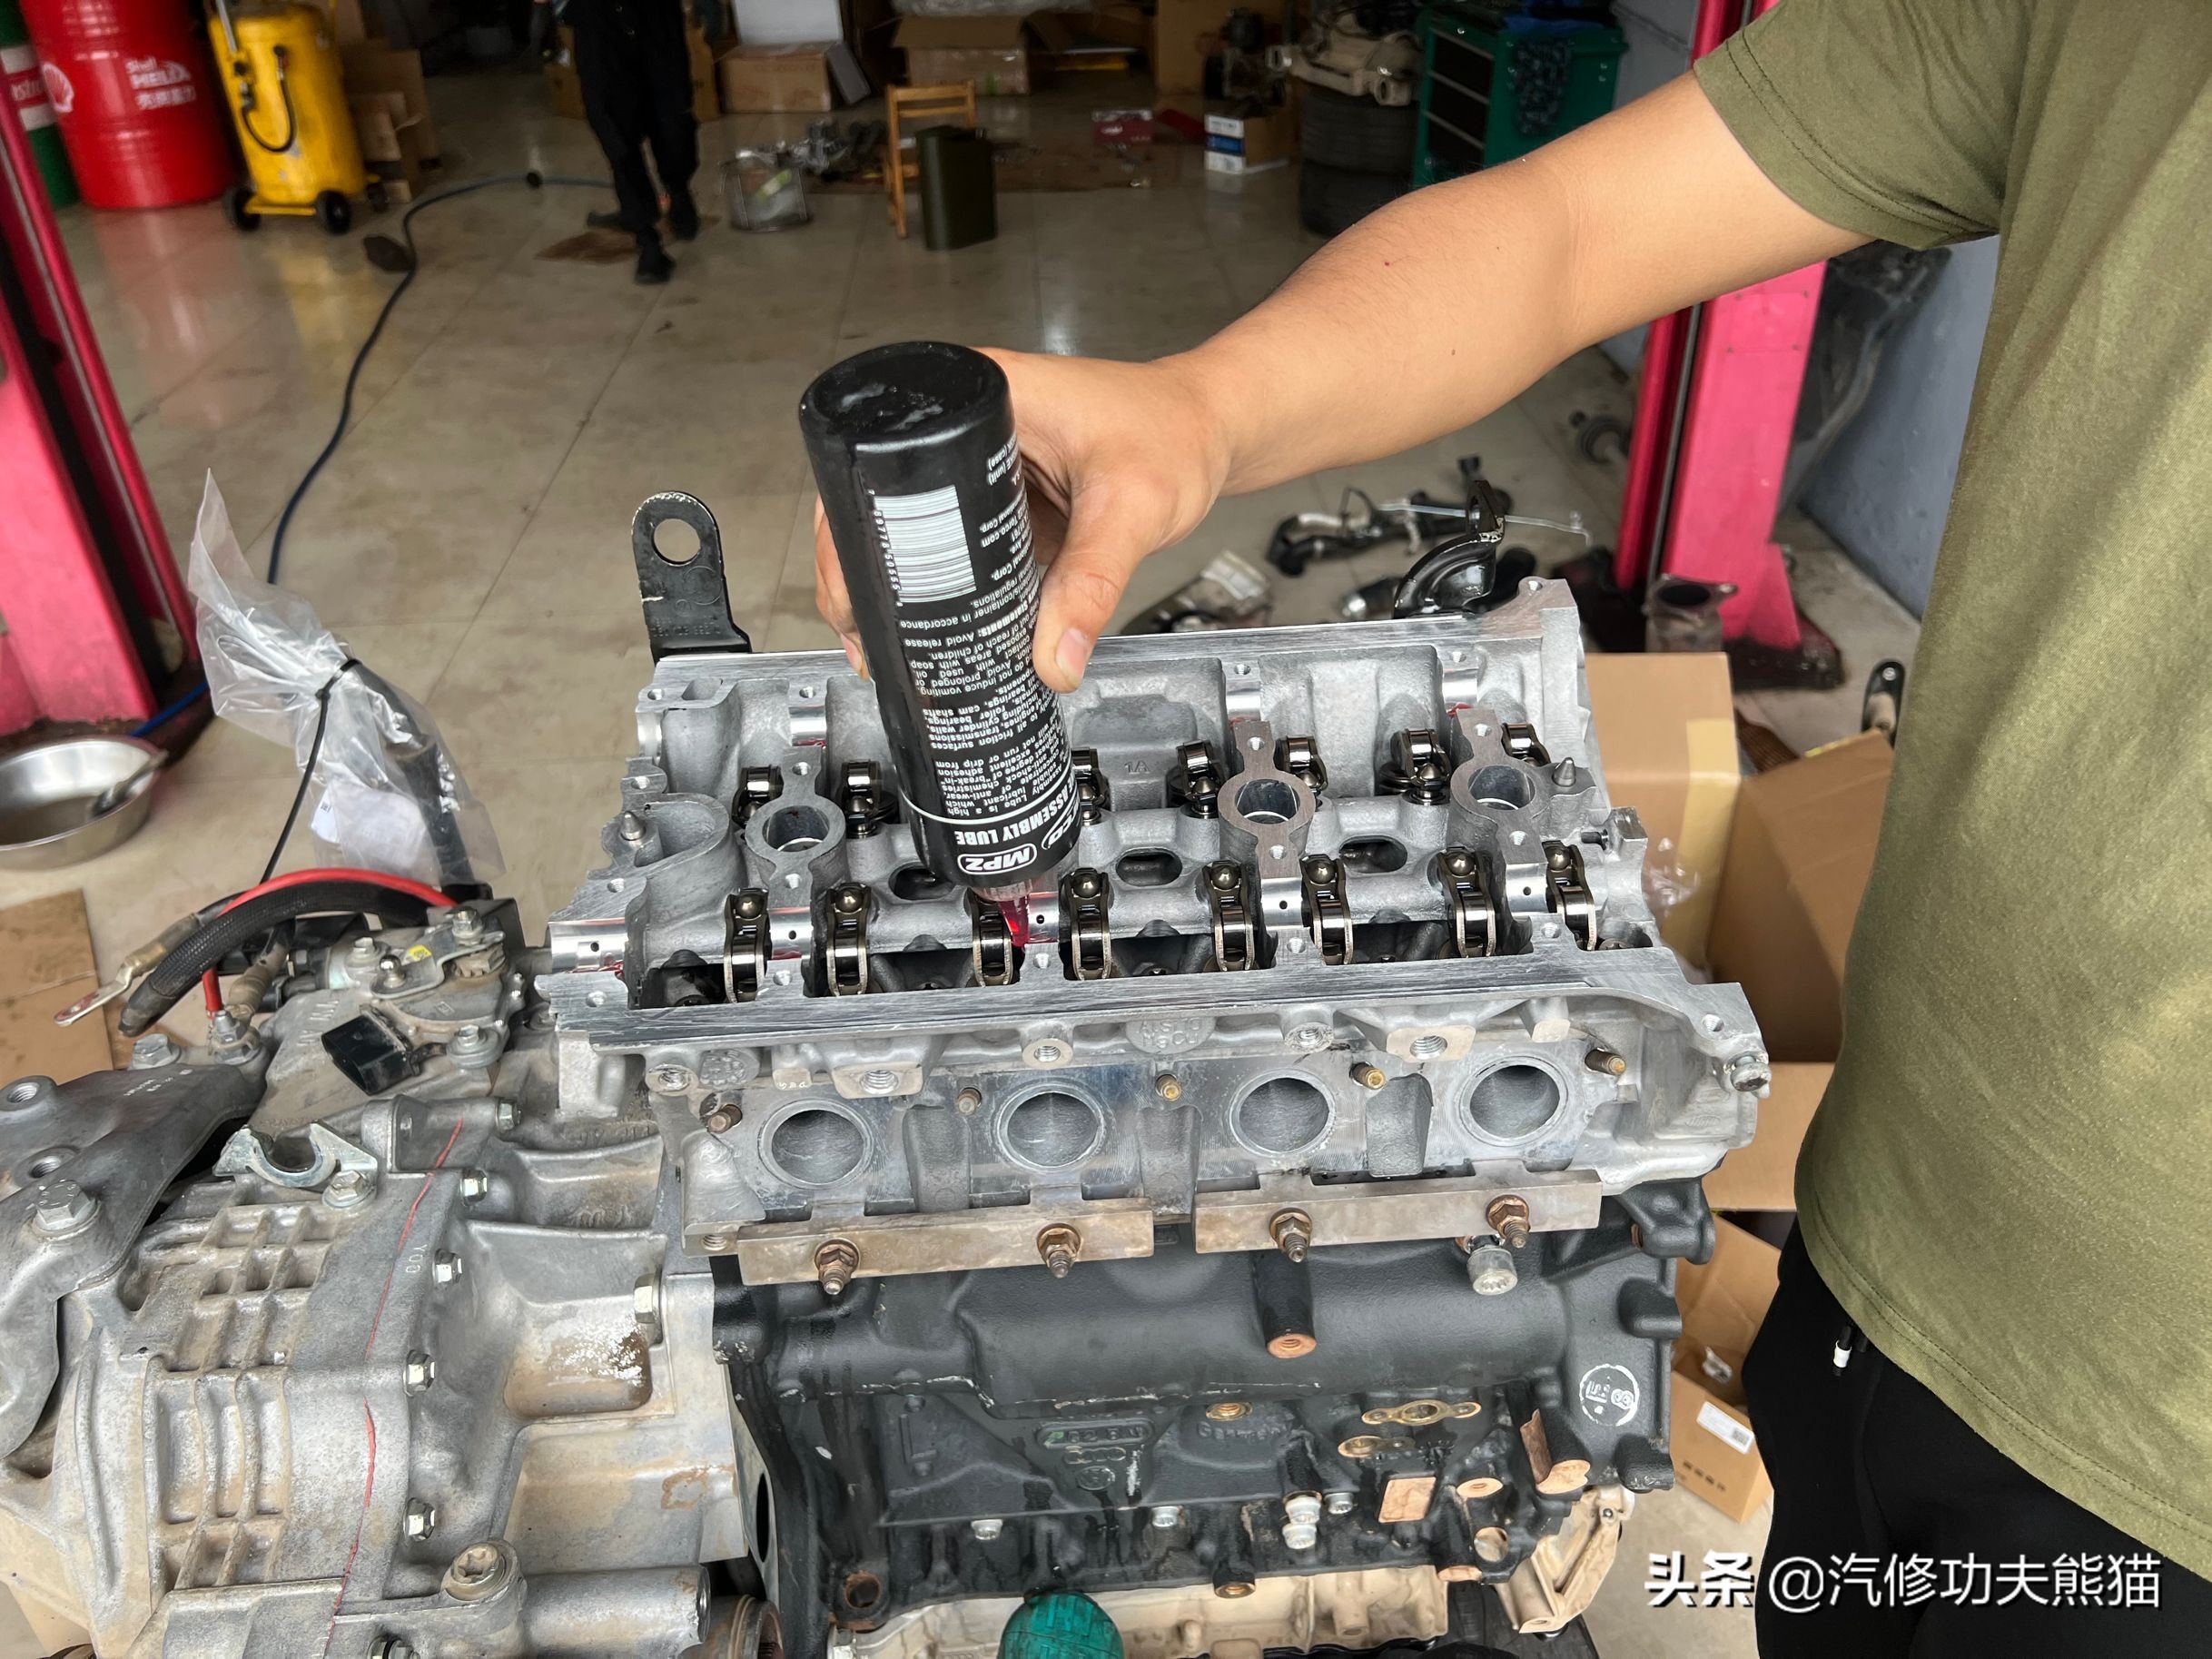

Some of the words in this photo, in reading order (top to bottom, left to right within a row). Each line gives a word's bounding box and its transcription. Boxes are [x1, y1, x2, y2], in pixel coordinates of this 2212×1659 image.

[988, 444, 1008, 470] (case)
[988, 461, 1006, 486] (unit)
[980, 518, 999, 533] Corp.
[981, 515, 1018, 548] Torco.com
[992, 563, 1012, 581] Corp.
[970, 577, 1017, 607] regulations.
[901, 617, 958, 630] accordance
[962, 613, 972, 623] in
[977, 599, 1028, 637] Statements:
[1012, 624, 1019, 636] of
[904, 638, 942, 648] release
[946, 632, 973, 647] Avoid
[986, 630, 1010, 648] reach
[996, 627, 1026, 655] exposed
[928, 647, 972, 660] children.
[973, 643, 983, 654] of
[1004, 635, 1030, 659] contact
[964, 649, 992, 665] areas
[910, 659, 934, 670] soap
[939, 659, 961, 670] with
[975, 658, 995, 672] with
[986, 659, 1012, 677] Avoid
[1015, 661, 1024, 671] do
[913, 670, 927, 678] oil.
[932, 672, 981, 688] prolonged
[939, 668, 964, 678] used
[999, 668, 1012, 681] not
[964, 676, 997, 692] induce
[984, 684, 1026, 708] bearings,
[923, 708, 953, 718] shafts
[958, 705, 981, 715] cam
[980, 705, 1005, 719] roller
[1002, 692, 1038, 721] including
[924, 716, 972, 726] bearings,
[1001, 705, 1035, 728] engines,
[1030, 713, 1038, 721] to
[959, 716, 1000, 732] cylinder
[1017, 720, 1027, 733] all
[928, 726, 999, 743] transmissions
[979, 728, 1013, 746] friction
[931, 741, 974, 751] surfaces
[1022, 736, 1035, 749] not
[1003, 746, 1019, 757] run
[935, 761, 959, 770] from
[963, 759, 984, 768] drip
[990, 749, 1030, 772] excellent
[1004, 755, 1033, 775] degree
[992, 771, 1002, 780] of
[1005, 754, 1046, 783] anti-shock
[942, 781, 999, 793] chemistries
[1002, 785, 1012, 794] of
[943, 790, 992, 799] anti-wear,
[983, 786, 1026, 806] lubricant
[1004, 794, 1027, 807] Lube
[989, 805, 998, 813] is
[1002, 785, 1068, 841] ASSEMBLY
[954, 829, 998, 844] LUBE
[966, 847, 1031, 871] MPZ
